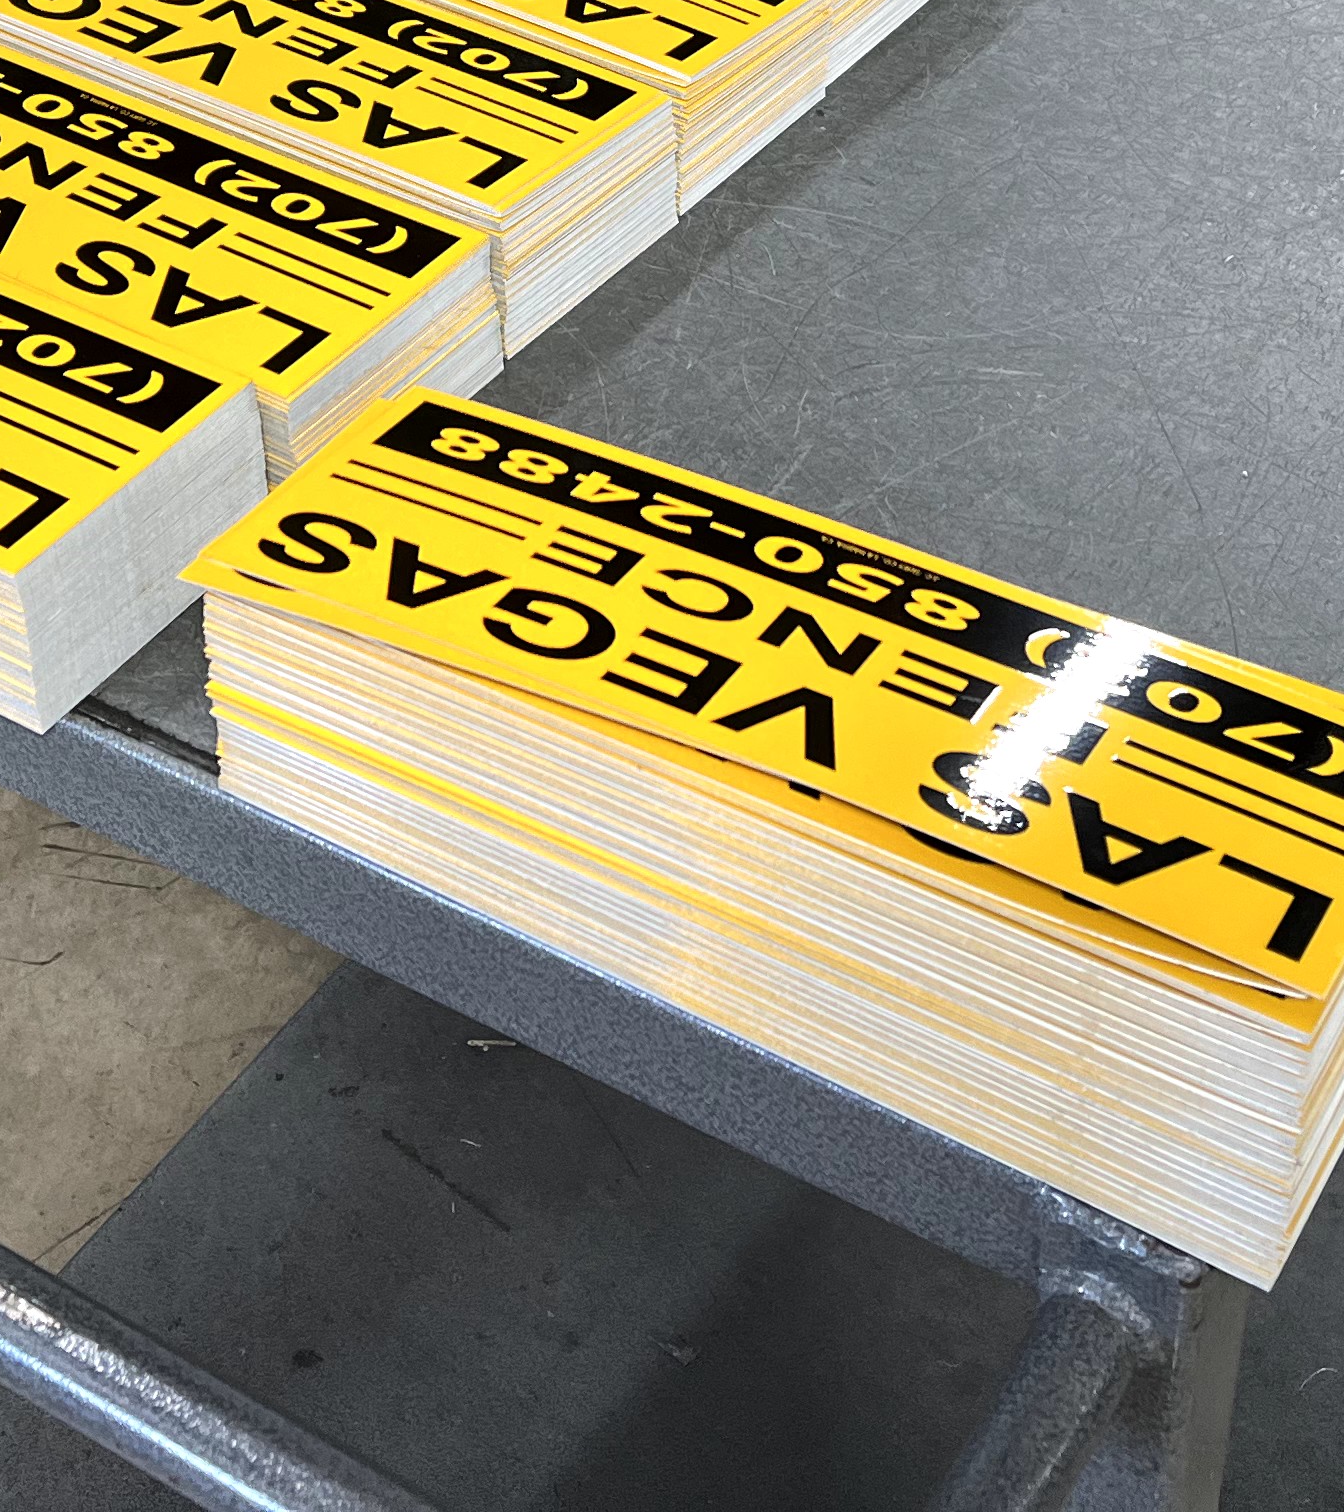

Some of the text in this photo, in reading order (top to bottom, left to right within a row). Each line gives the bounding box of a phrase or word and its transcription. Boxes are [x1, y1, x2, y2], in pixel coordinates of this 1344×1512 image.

[388, 20, 587, 98] (702)
[271, 79, 526, 188] LAS
[195, 160, 407, 252] (702)
[56, 241, 330, 373] LAS
[432, 425, 981, 632] 850-2488
[259, 510, 1334, 964] LAS VEGAS
